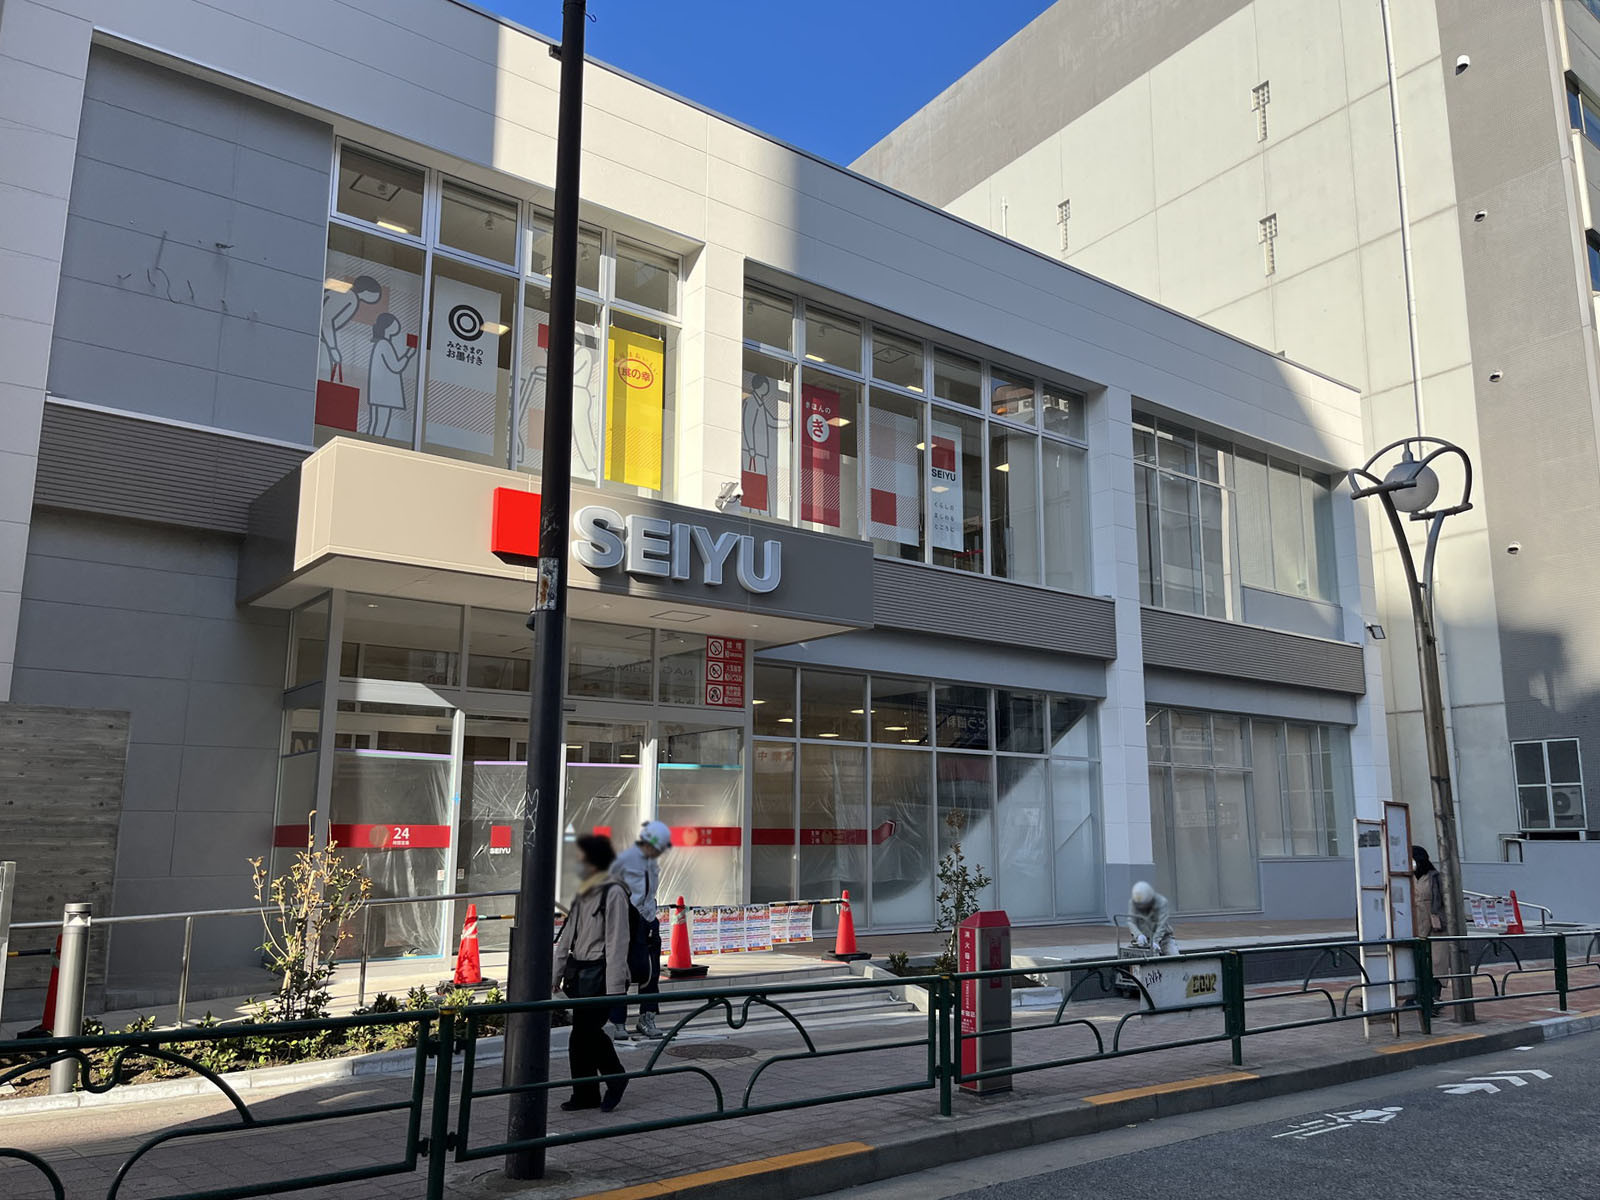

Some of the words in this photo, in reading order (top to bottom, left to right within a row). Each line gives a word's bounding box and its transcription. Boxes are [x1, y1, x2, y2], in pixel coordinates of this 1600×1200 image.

[447, 341, 484, 356] みなさまの
[446, 349, 483, 366] お墨付き
[812, 419, 823, 438] き
[931, 468, 956, 482] SEIYU
[572, 506, 782, 593] SEIYU
[393, 827, 410, 840] 24
